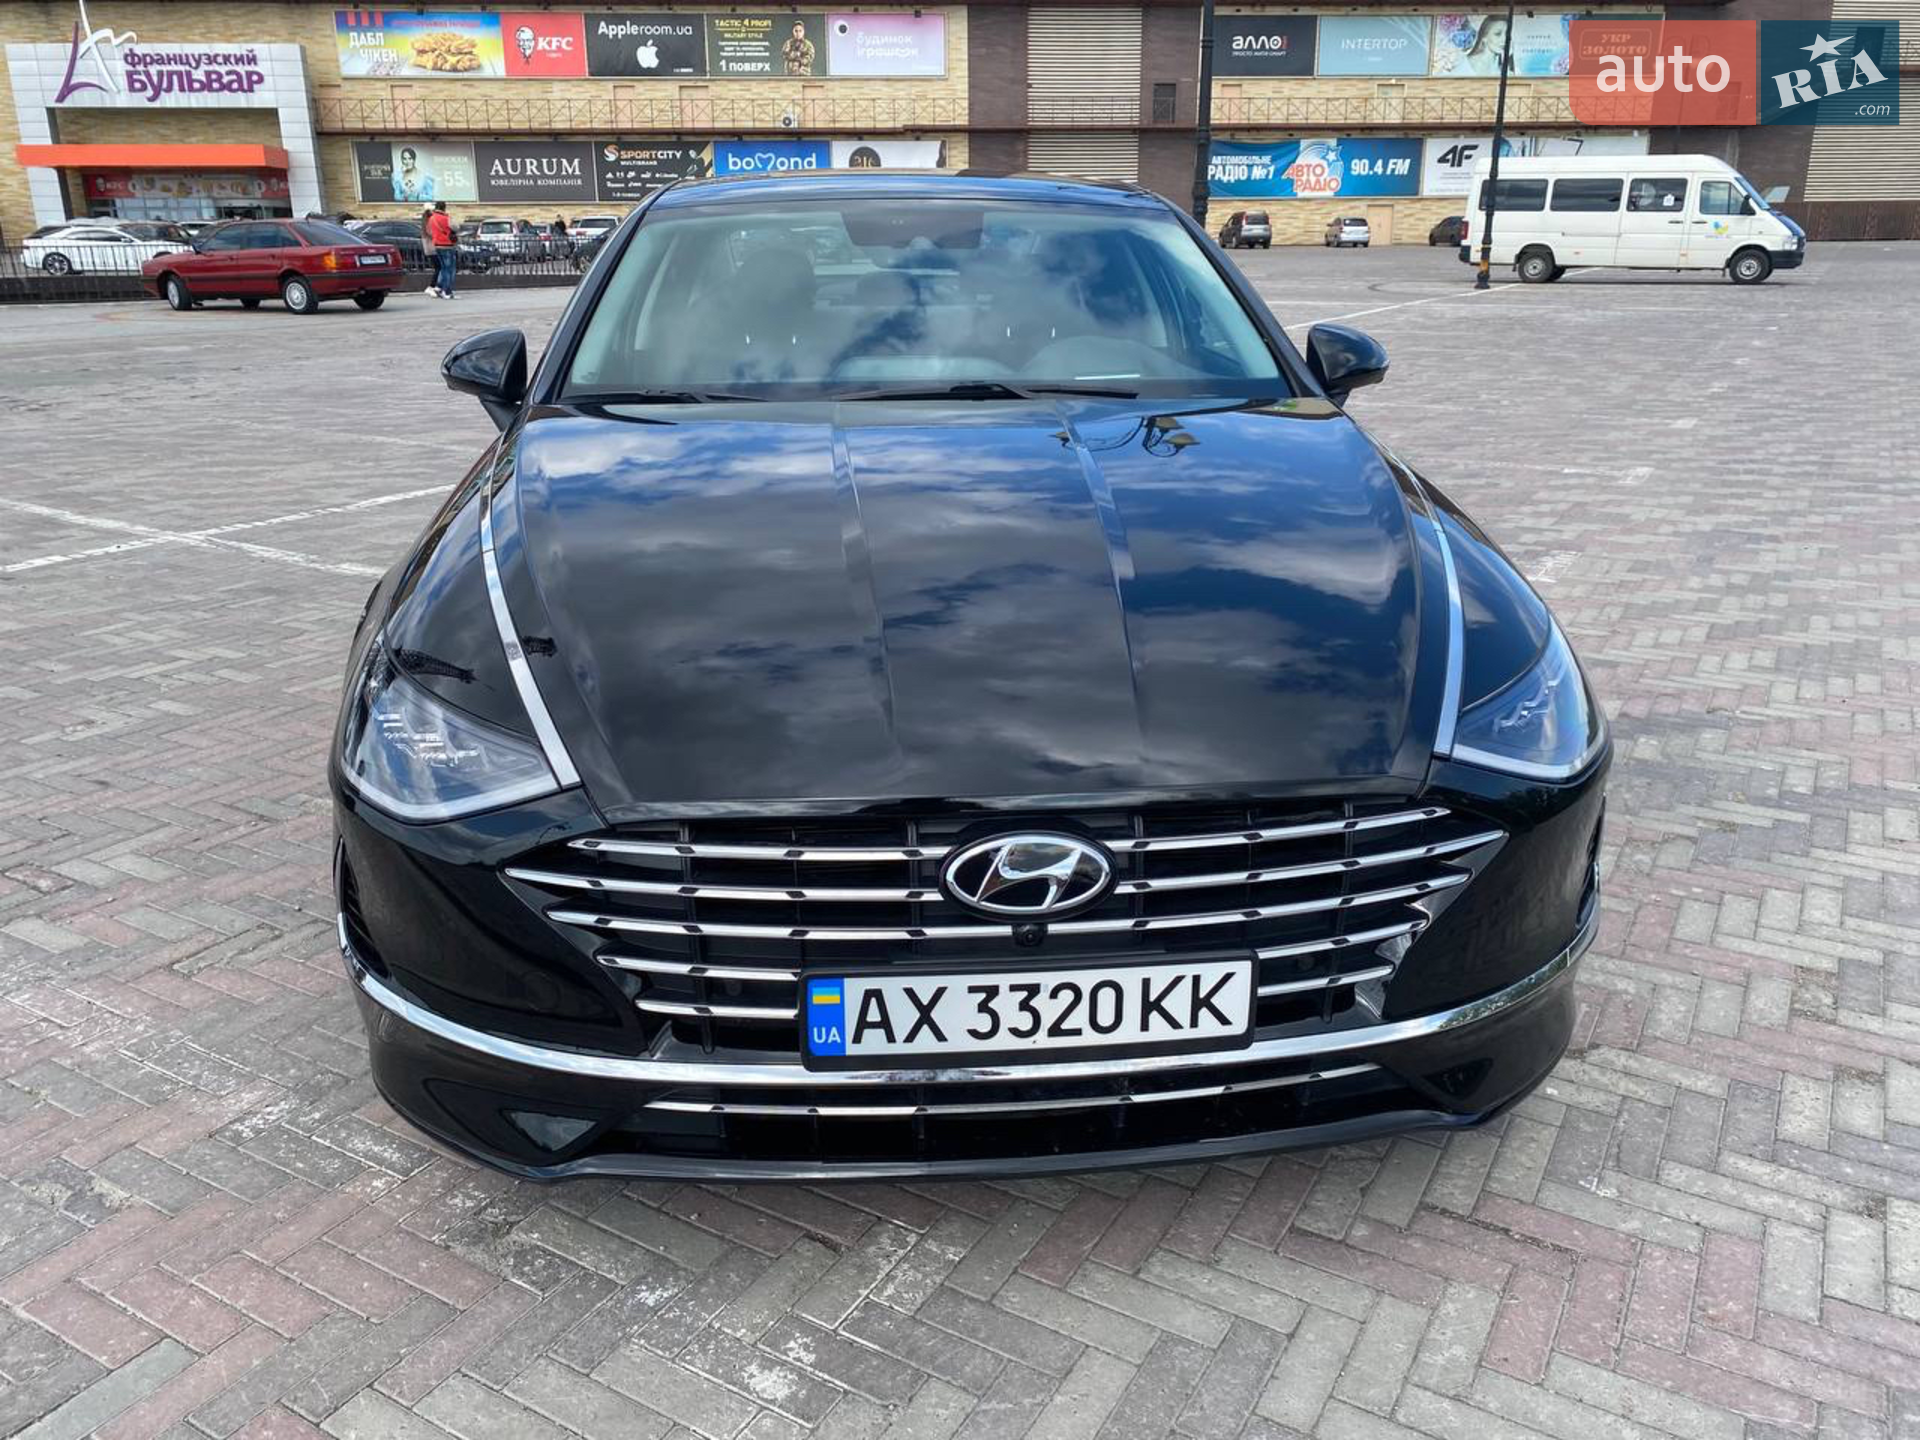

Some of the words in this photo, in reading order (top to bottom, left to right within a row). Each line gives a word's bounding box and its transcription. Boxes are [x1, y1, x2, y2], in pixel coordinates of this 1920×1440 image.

[598, 20, 693, 39] Appleroom.ua
[743, 18, 750, 27] 4
[349, 32, 385, 48] ДАБЛ
[537, 37, 573, 51] KFC
[855, 32, 912, 46] будинок
[1341, 38, 1407, 49] INTERTOP
[1601, 33, 1632, 43] УКР
[359, 47, 398, 62] ЧІКЕН
[1582, 45, 1647, 55] ЗОЛОТО
[123, 47, 258, 70] французский
[719, 58, 726, 72] 1
[728, 62, 770, 72] ПОВЕРХ
[620, 150, 682, 160] SPORTCITY
[1212, 155, 1272, 165] АВТОМОБІЛЬНЕ
[1437, 144, 1478, 168] 4F
[490, 159, 581, 175] AURUM
[1282, 163, 1327, 178] АВТО
[1351, 159, 1383, 175] 90.4
[1386, 158, 1411, 175] FM
[1207, 165, 1248, 183] РАДІО
[1251, 165, 1275, 181] №1
[491, 178, 535, 186] ЮВЕЛІРНА
[537, 178, 582, 186] КОМПАНІЯ
[1295, 178, 1340, 192] РАДІО
[851, 986, 949, 1045] AX
[966, 979, 1125, 1041] 3320
[1139, 971, 1237, 1033] KK
[813, 1027, 841, 1044] UA
